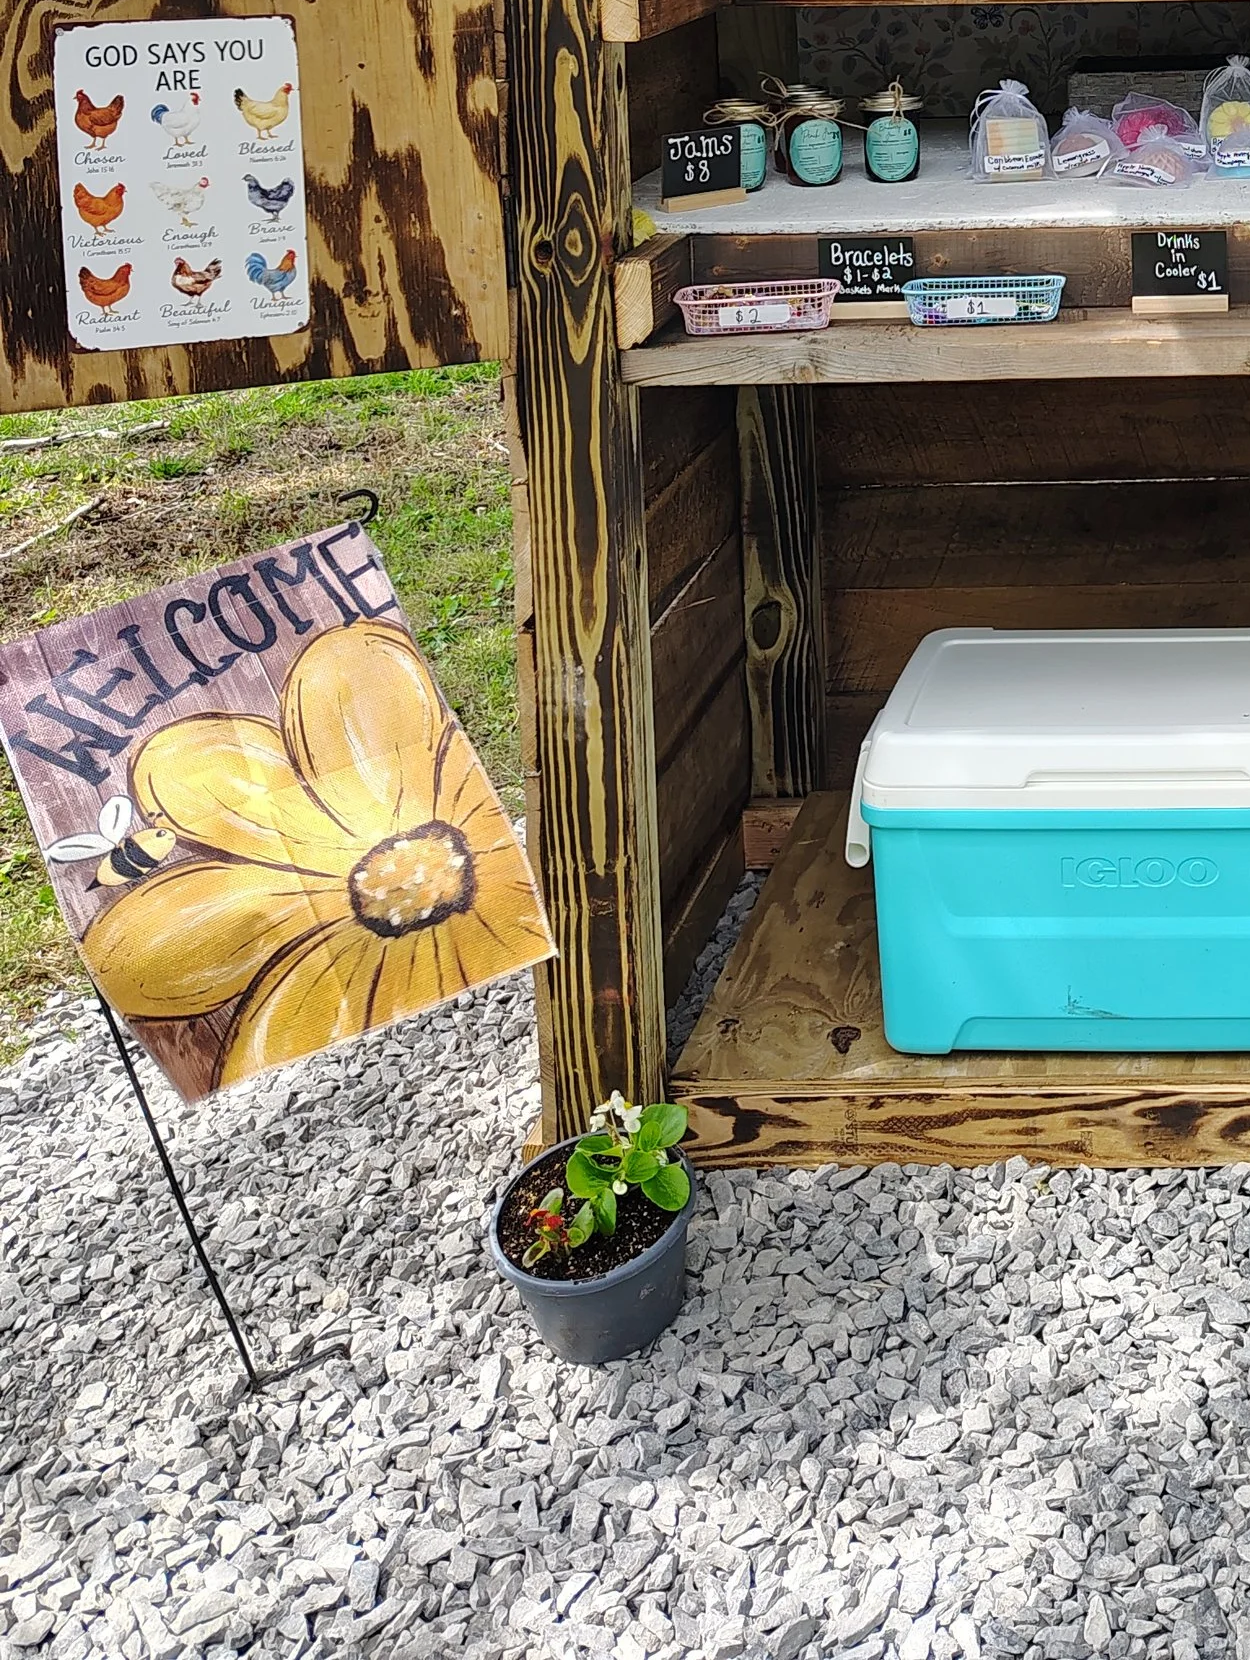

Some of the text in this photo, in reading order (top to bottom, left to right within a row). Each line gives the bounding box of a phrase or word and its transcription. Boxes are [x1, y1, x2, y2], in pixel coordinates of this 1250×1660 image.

[85, 39, 264, 67] GOD SAYS YOU
[156, 69, 202, 91] ARE
[162, 145, 209, 161] Loved
[238, 140, 297, 156] Blessed
[668, 135, 733, 160] Jams
[74, 152, 127, 165] Chosen
[685, 160, 710, 182] $8
[161, 226, 220, 244] Enough
[248, 221, 296, 235] Brave
[67, 235, 145, 249] Victorious
[1157, 231, 1200, 250] Drinks
[831, 242, 914, 266] Bracelets
[1171, 249, 1186, 263] in
[1155, 261, 1197, 278] Cooler
[1196, 270, 1222, 291] $1
[160, 300, 232, 319] Beautiful
[250, 297, 305, 312] Unique
[967, 298, 990, 315] $1
[75, 309, 141, 326] Radiant
[7, 522, 400, 788] WELCOME
[1060, 856, 1220, 888] IGLOO
